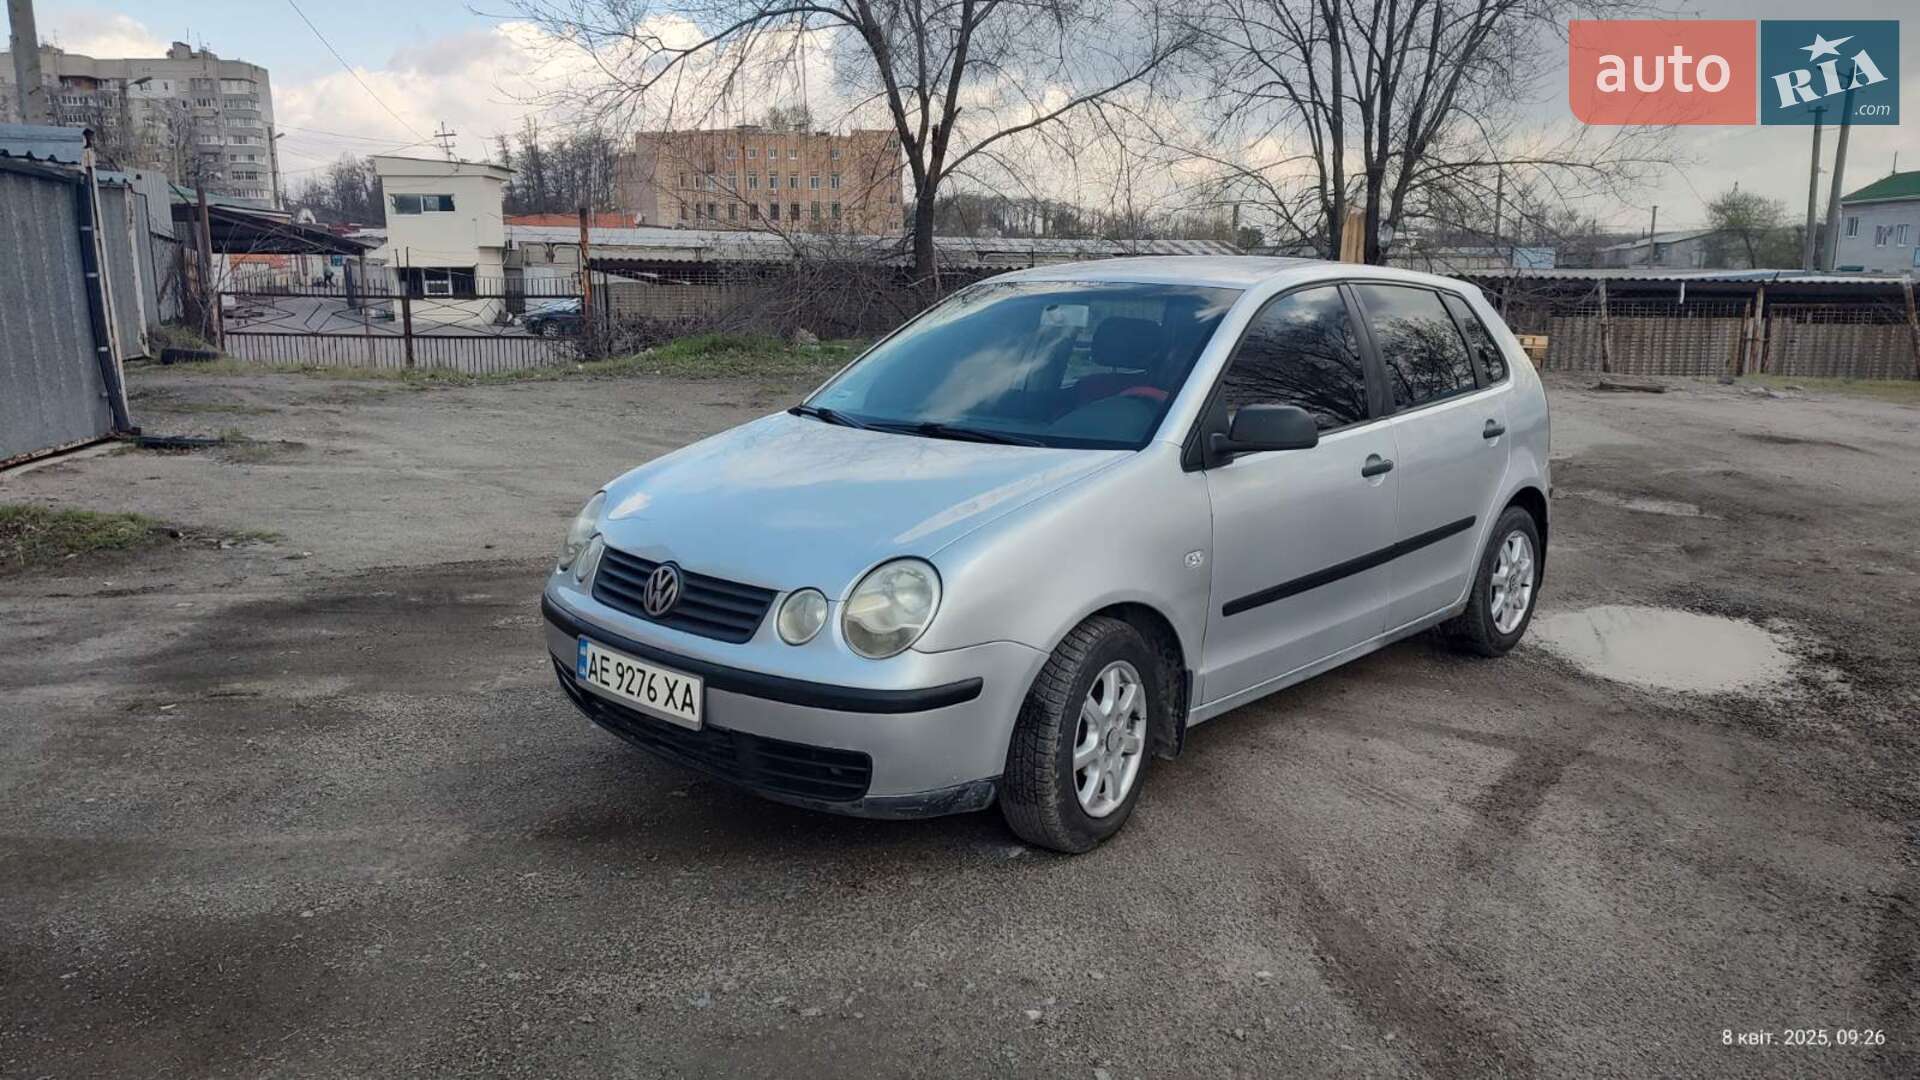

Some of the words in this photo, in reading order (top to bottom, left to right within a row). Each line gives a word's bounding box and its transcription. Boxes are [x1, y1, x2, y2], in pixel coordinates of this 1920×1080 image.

[588, 652, 610, 687] AE
[615, 662, 657, 703] 9276
[664, 676, 695, 715] XA
